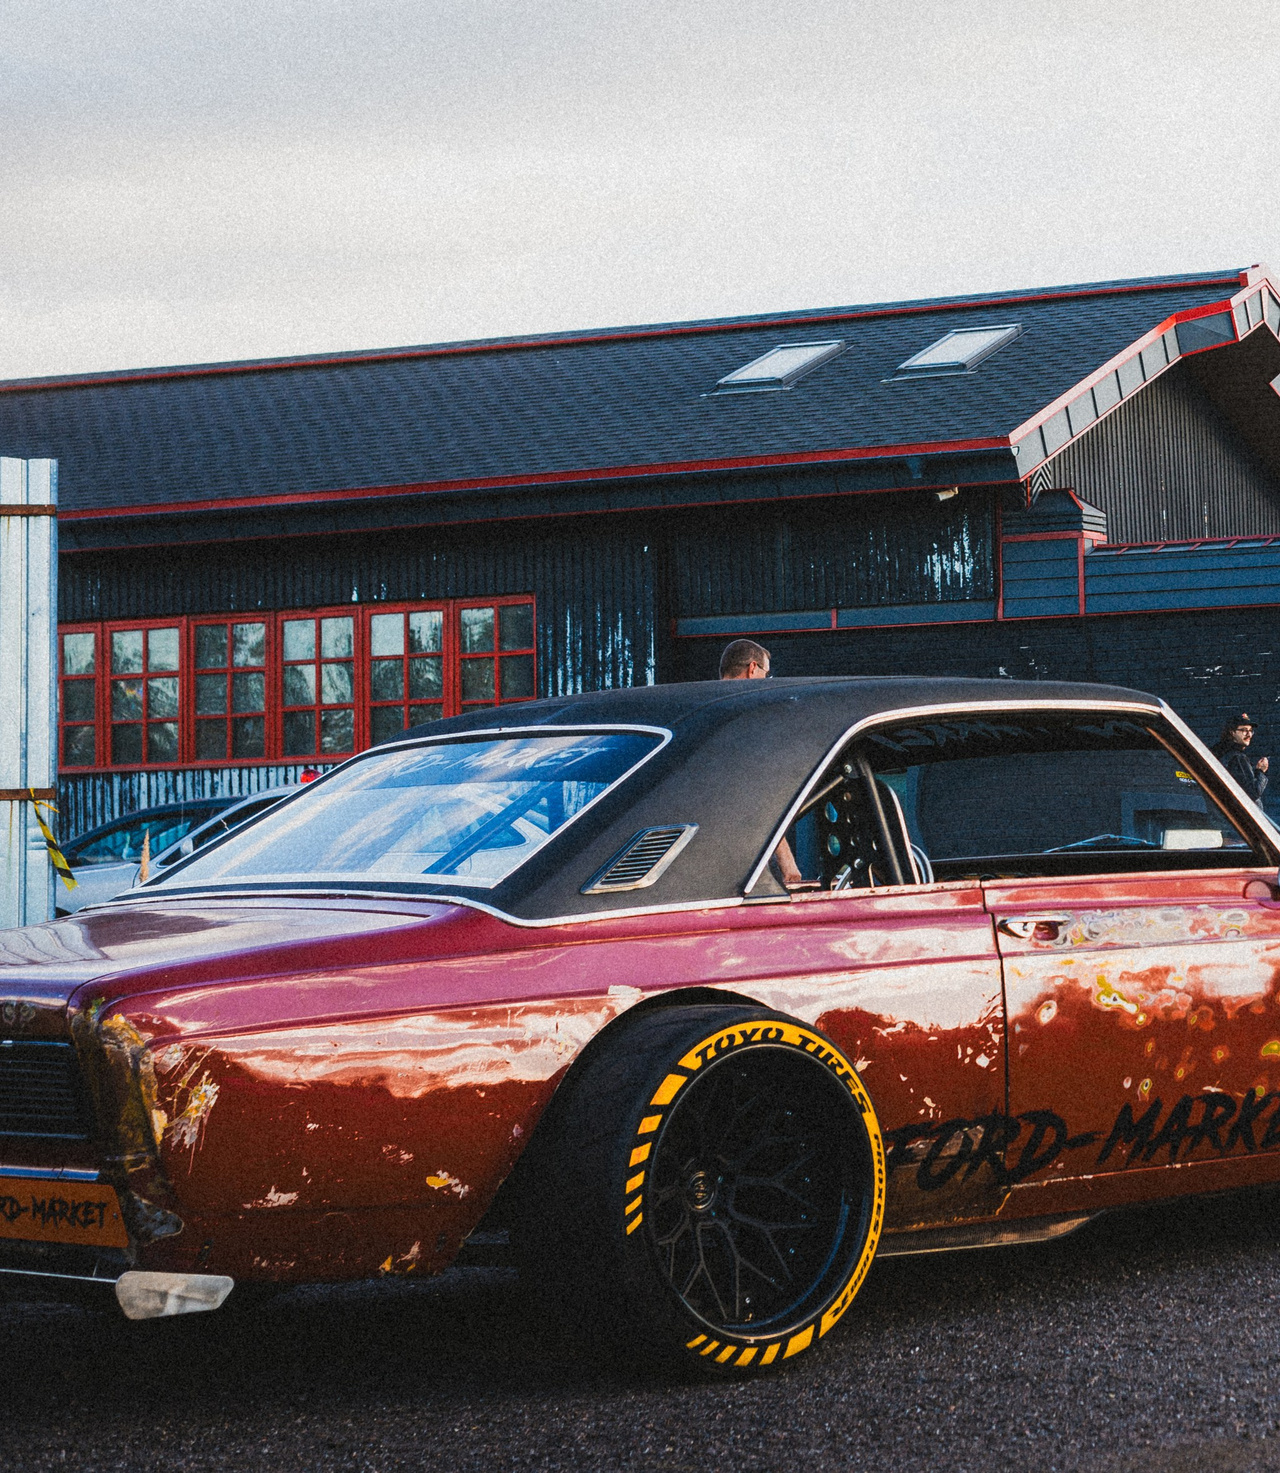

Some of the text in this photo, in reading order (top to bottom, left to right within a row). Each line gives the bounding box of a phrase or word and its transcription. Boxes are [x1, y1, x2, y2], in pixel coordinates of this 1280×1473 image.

[695, 1026, 785, 1064] TOYO
[798, 1033, 873, 1115] TIRES
[872, 1132, 884, 1236] PROXES
